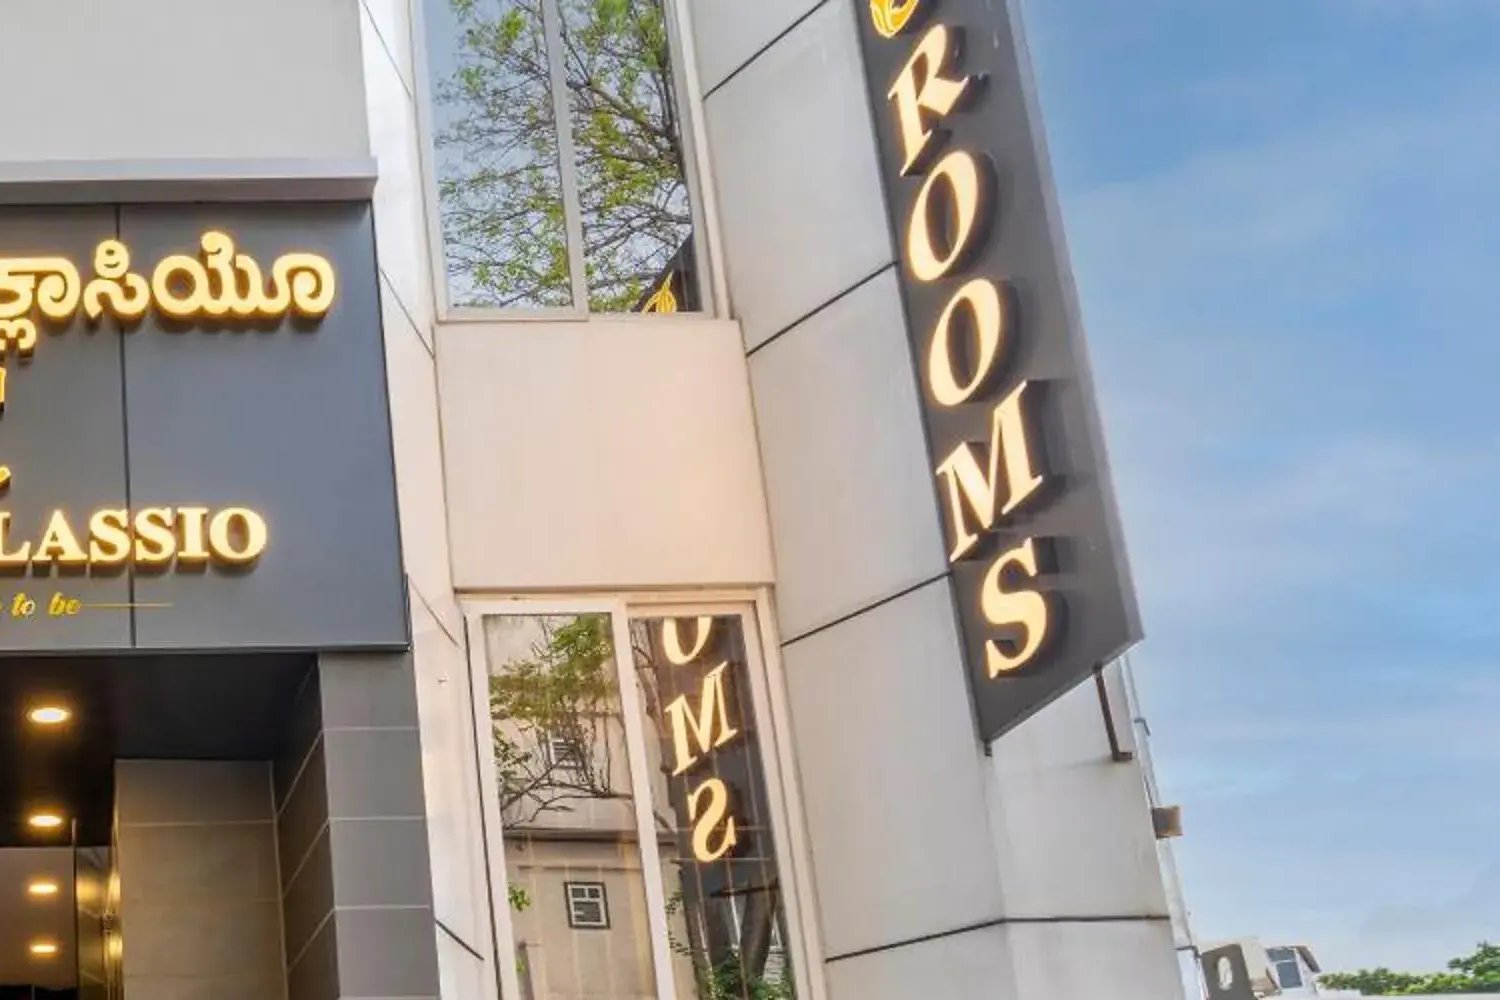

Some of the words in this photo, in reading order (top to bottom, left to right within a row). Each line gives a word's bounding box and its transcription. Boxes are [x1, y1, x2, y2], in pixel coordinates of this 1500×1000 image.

[888, 23, 1048, 680] ROOMS
[12, 593, 35, 617] to
[48, 592, 82, 616] be
